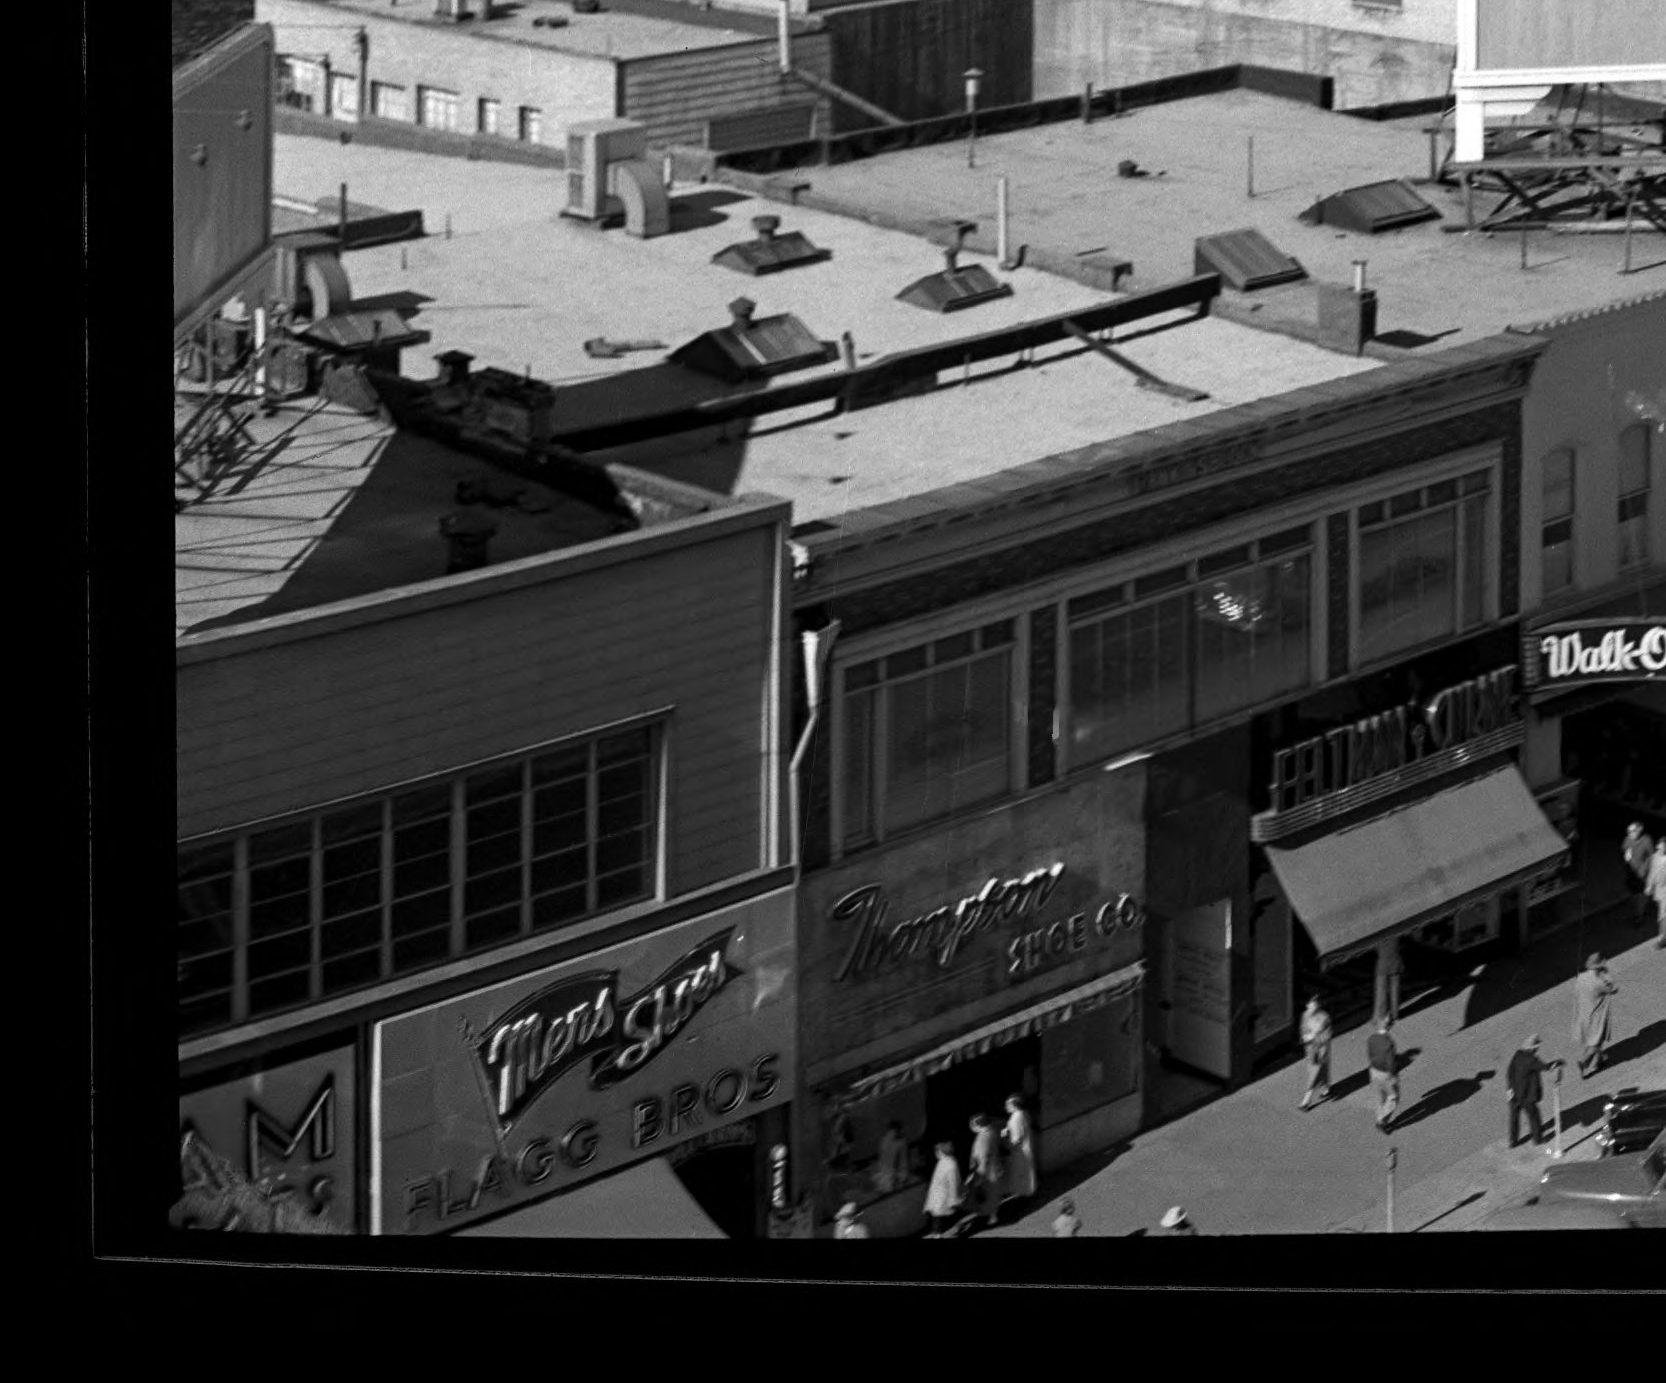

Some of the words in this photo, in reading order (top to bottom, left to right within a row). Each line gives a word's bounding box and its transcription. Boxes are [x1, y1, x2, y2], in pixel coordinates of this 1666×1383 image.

[831, 860, 1067, 985] Thompson
[1007, 911, 1088, 976] SHOE
[403, 1117, 600, 1223] FLAGG
[631, 1050, 782, 1149] BROS
